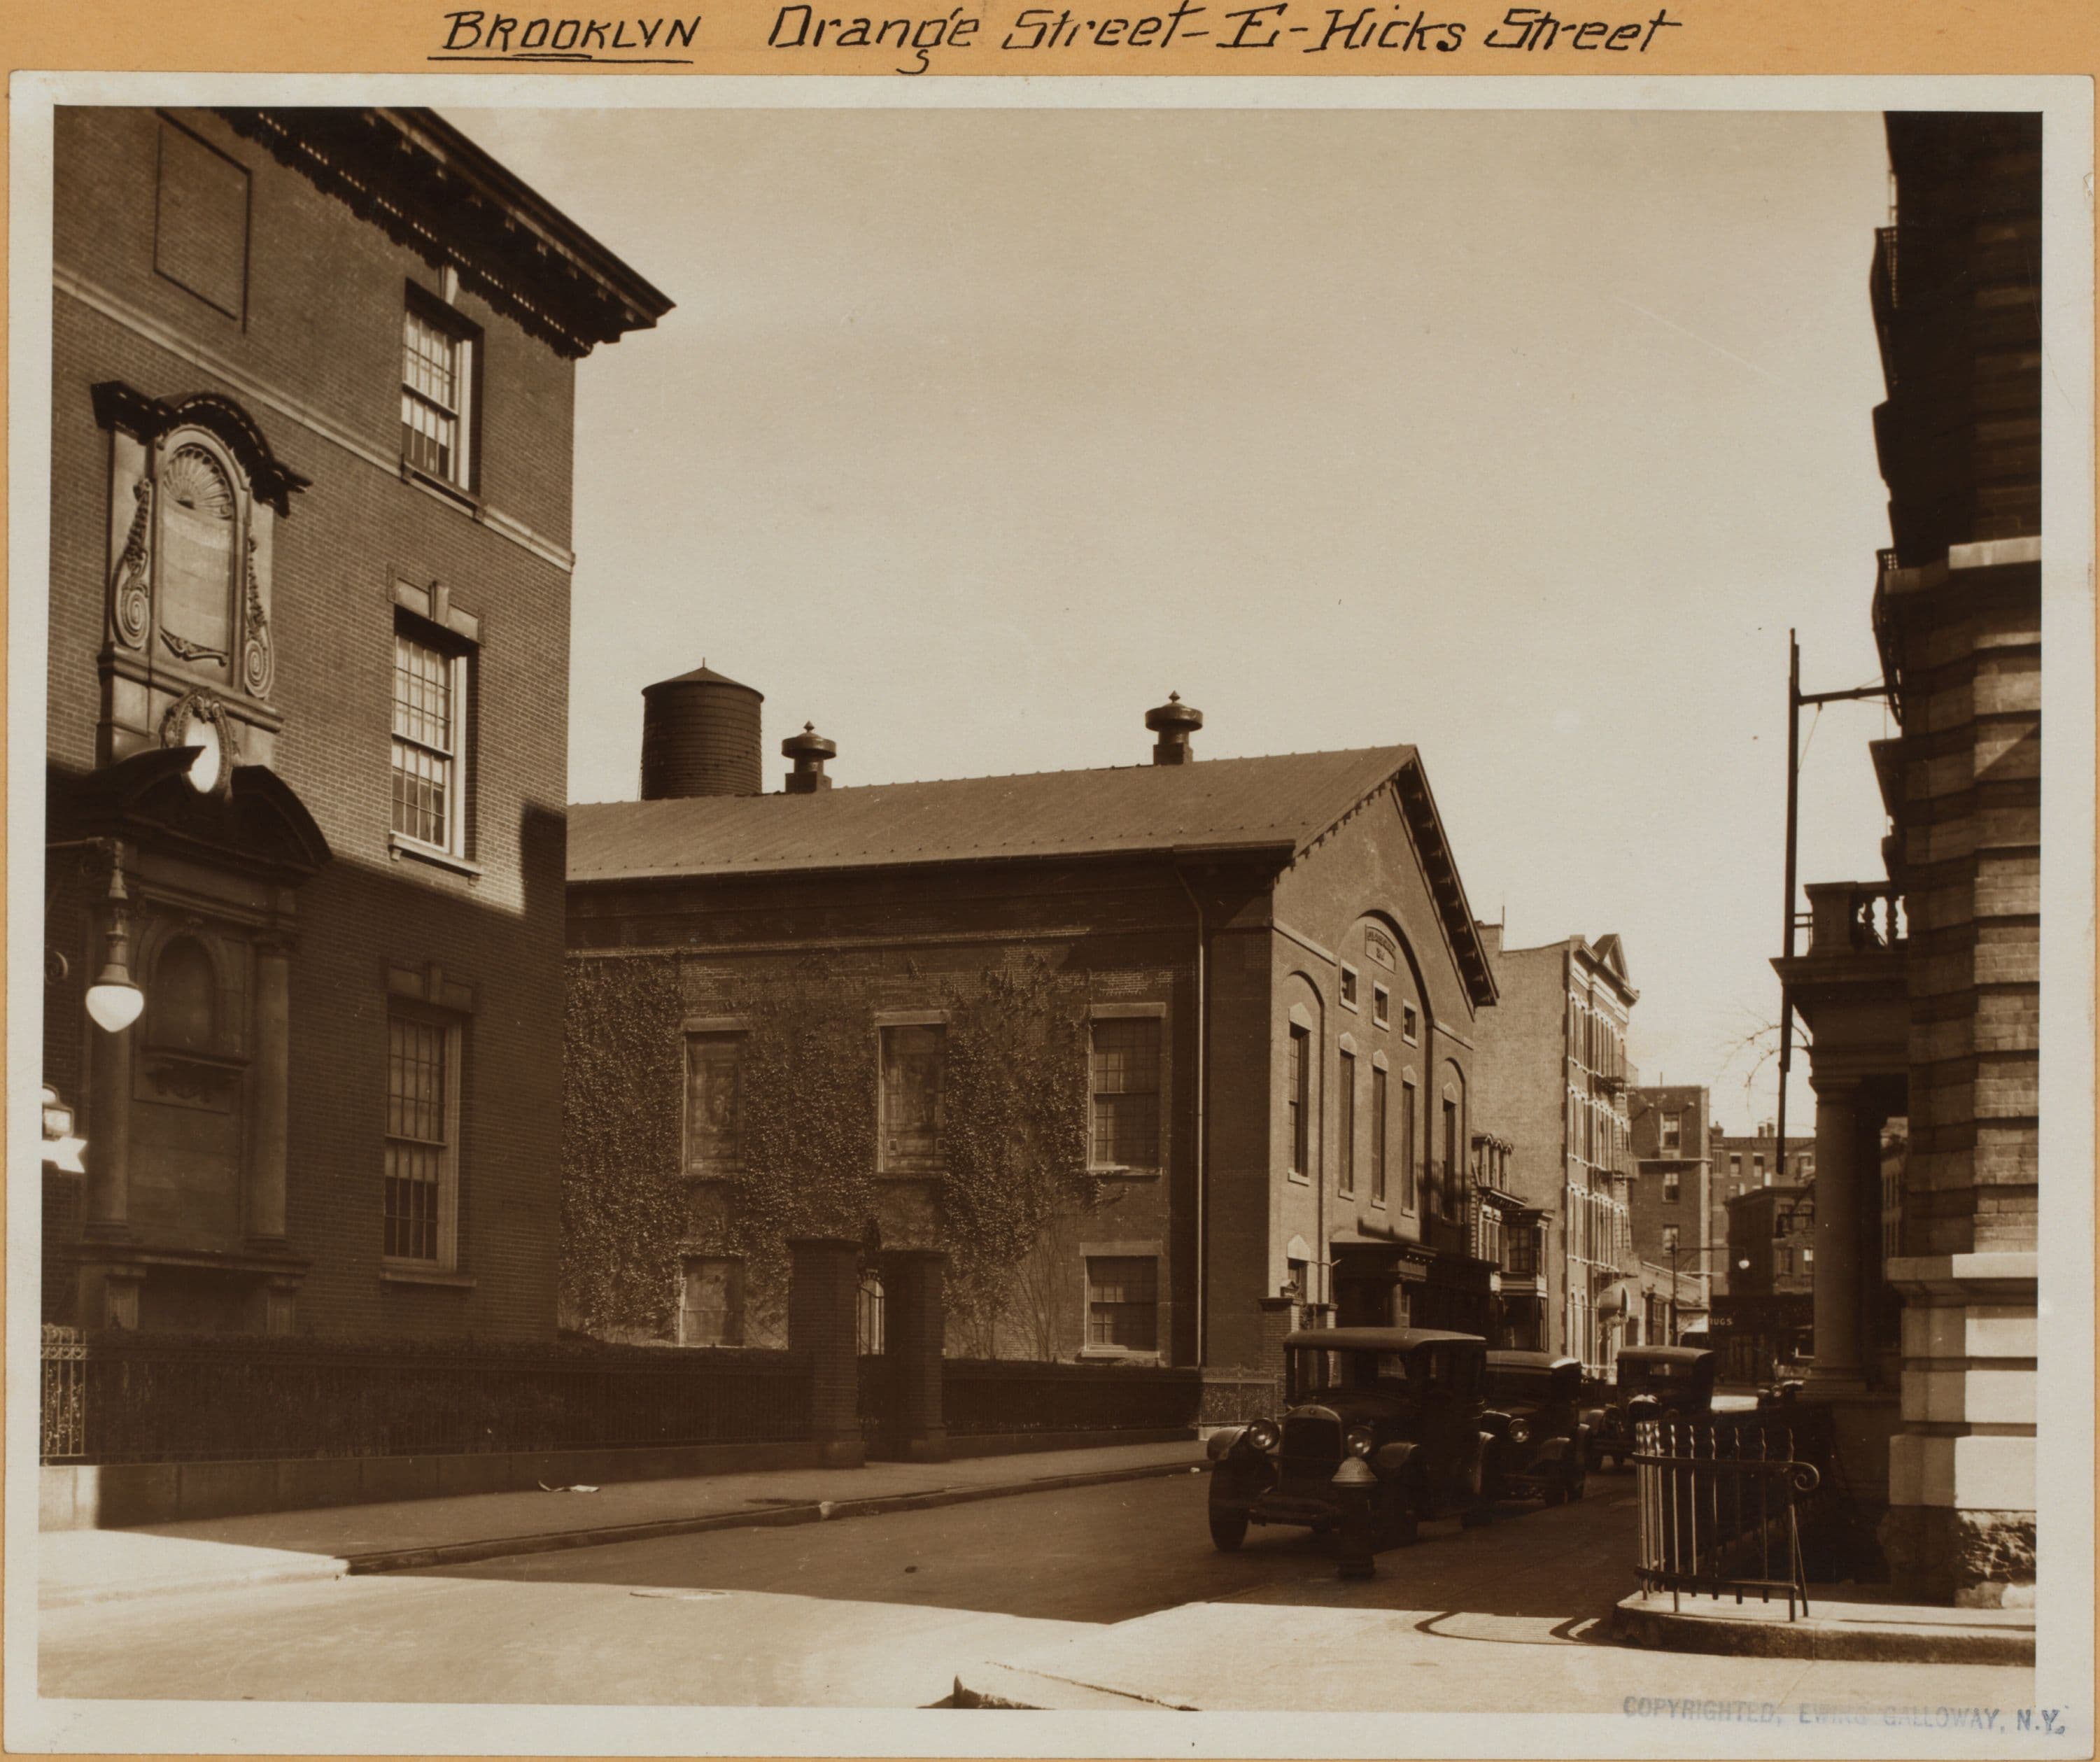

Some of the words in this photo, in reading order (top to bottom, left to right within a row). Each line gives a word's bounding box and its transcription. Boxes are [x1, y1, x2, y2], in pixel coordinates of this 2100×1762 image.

[441, 10, 702, 52] BROOKLYN
[767, 4, 980, 75] Orange
[1483, 8, 1683, 52] Street
[1709, 1317, 1733, 1326] RUGS
